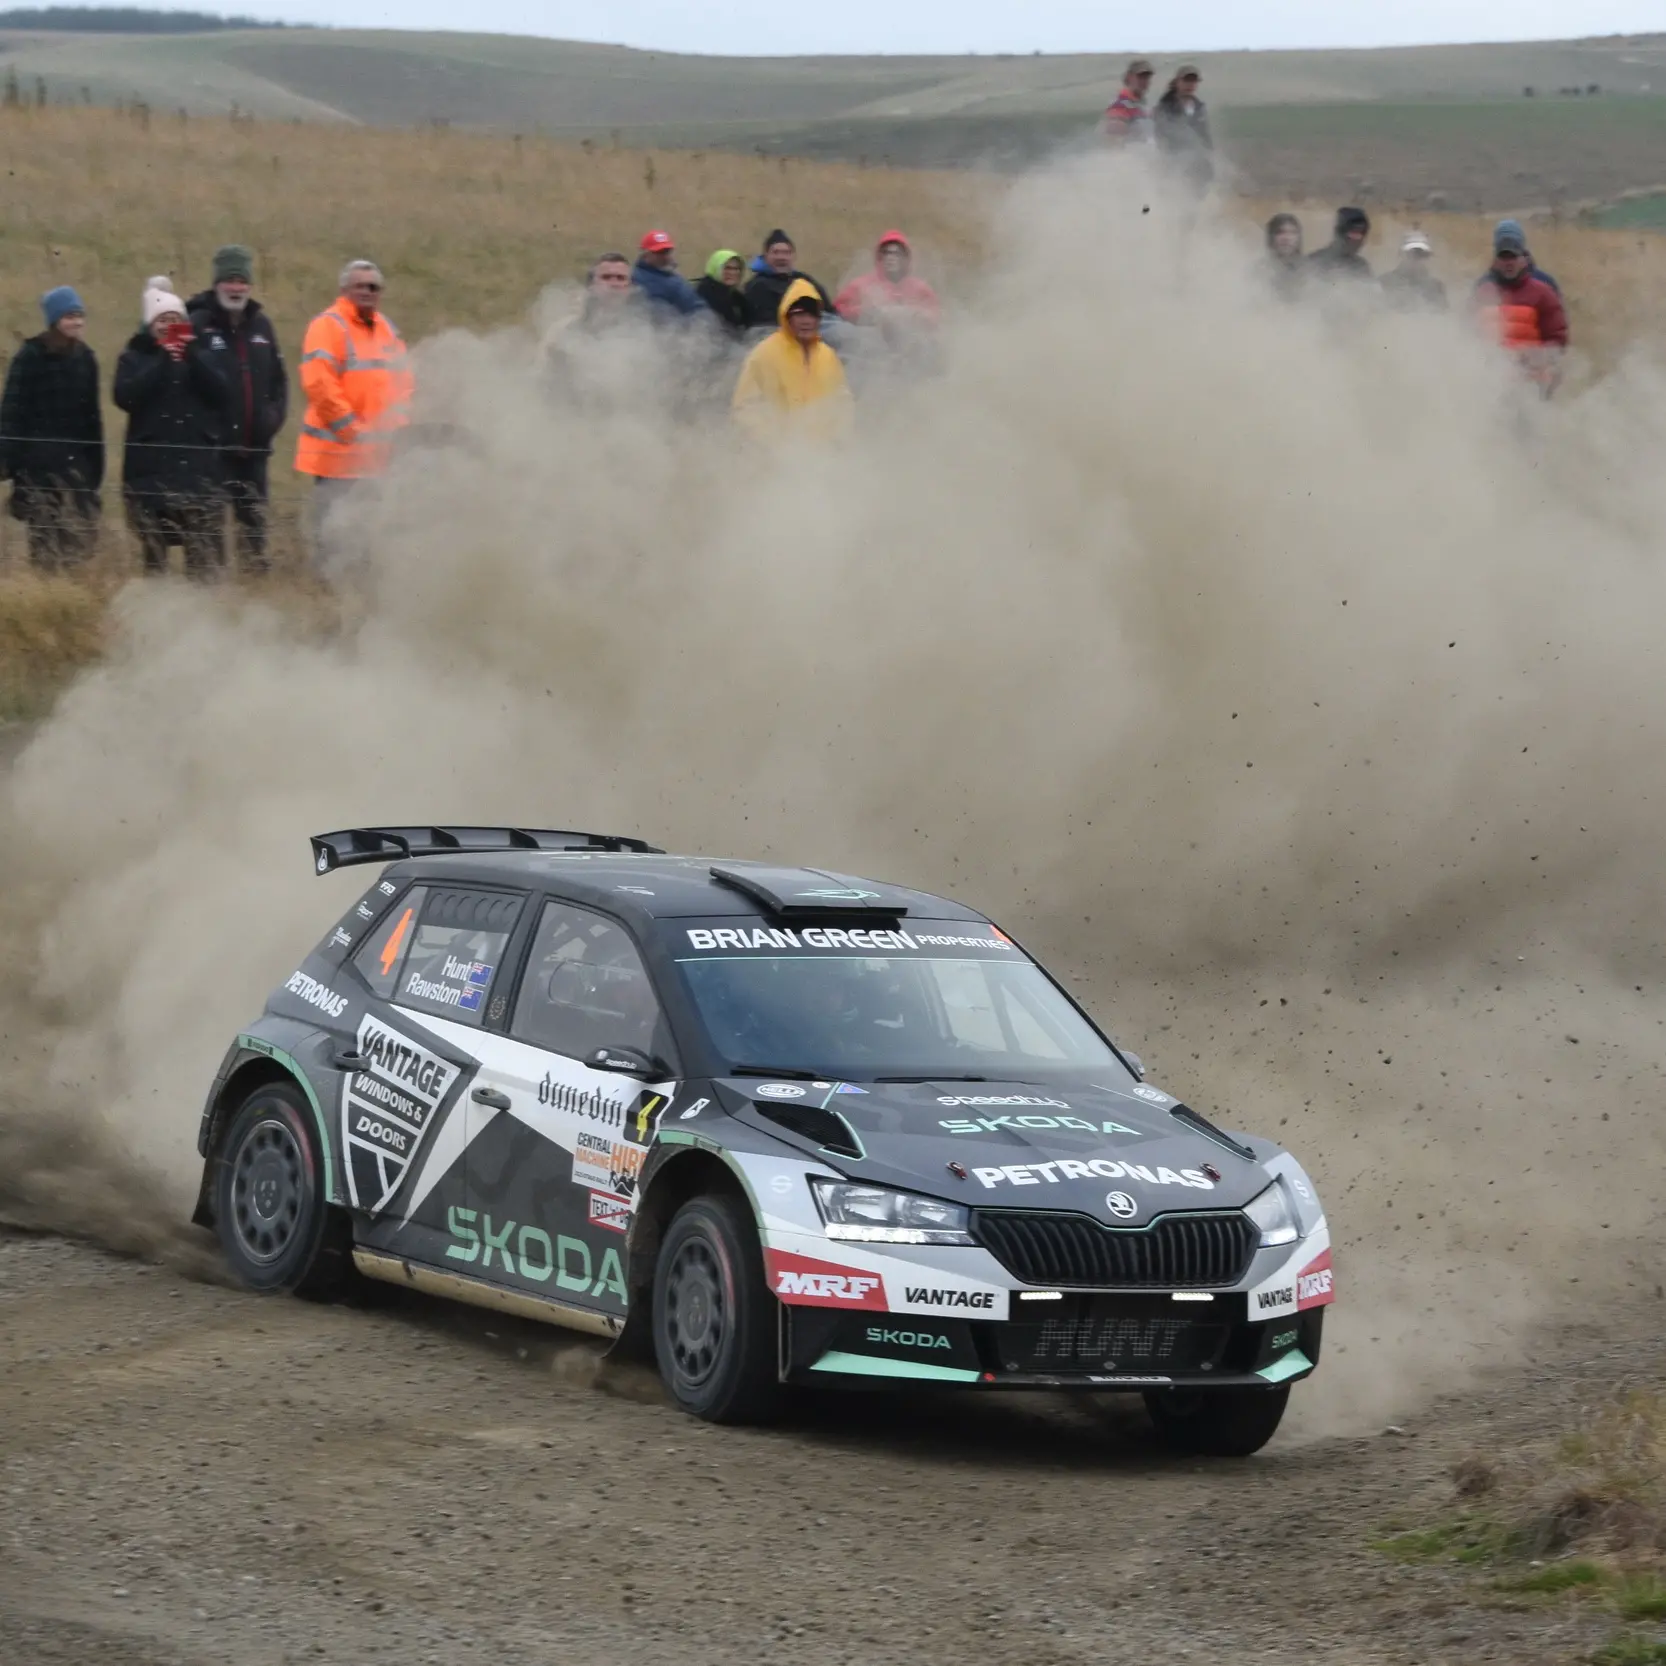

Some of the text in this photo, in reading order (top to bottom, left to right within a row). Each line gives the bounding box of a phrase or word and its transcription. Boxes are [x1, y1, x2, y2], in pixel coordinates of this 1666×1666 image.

[686, 928, 1011, 951] BRIAN GREEN PROPERTIES
[441, 954, 473, 982] Hunt
[284, 970, 349, 1018] PETRONAS
[363, 1025, 447, 1100] VANTAGE
[355, 1073, 423, 1121] WINDOWS &
[355, 1116, 407, 1151] DOORS
[577, 1132, 611, 1155] CENTRAL
[938, 1115, 1143, 1136] SKODA
[971, 1159, 1215, 1190] PETRONAS
[445, 1205, 628, 1306] SKODA
[776, 1271, 994, 1309] MRF VANTAGE
[1257, 1268, 1333, 1309] VANTAGE MRF
[866, 1327, 952, 1349] SKODA
[1033, 1318, 1193, 1357] HUNT
